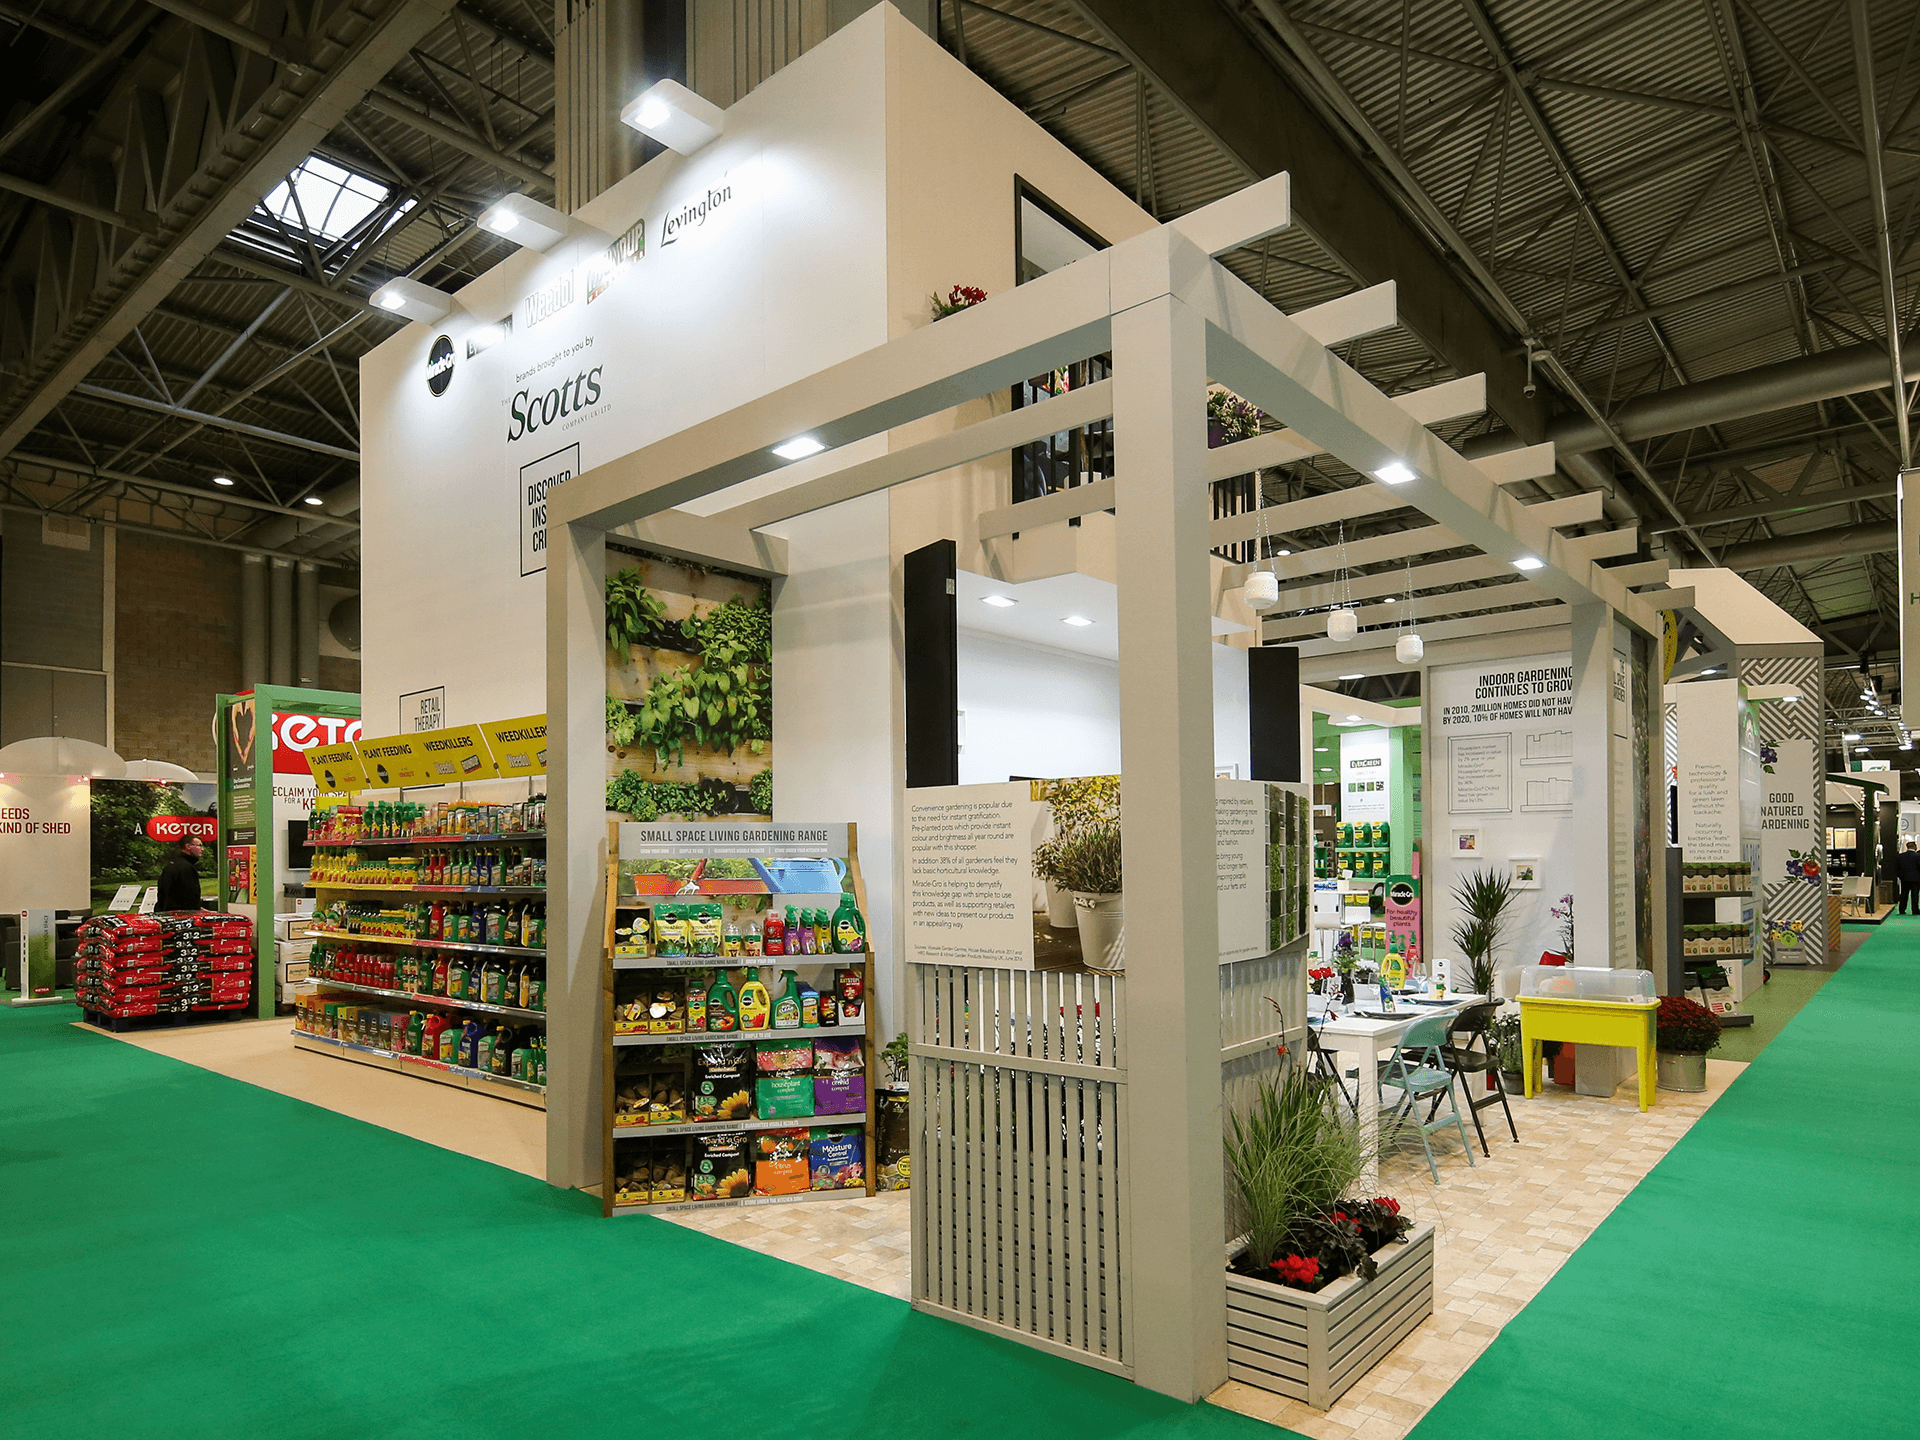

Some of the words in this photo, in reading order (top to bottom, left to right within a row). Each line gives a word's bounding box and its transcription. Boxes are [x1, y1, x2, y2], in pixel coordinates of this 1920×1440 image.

[660, 182, 732, 249] Levington
[516, 366, 535, 382] brands
[537, 353, 562, 372] brought
[563, 348, 570, 358] to
[572, 341, 584, 356] you
[585, 336, 594, 347] by
[507, 364, 603, 442] Scotts
[1479, 673, 1515, 686] INDOOR
[1476, 683, 1528, 699] CONTINUES
[1532, 682, 1544, 694] TO
[420, 696, 440, 714] RETAIL
[1472, 703, 1501, 713] 2MILLION
[1503, 700, 1527, 709] HOMES
[1529, 699, 1540, 708] DID
[1542, 698, 1555, 706] NOT
[415, 713, 441, 732] THERAPY
[1443, 716, 1451, 725] BY
[1474, 713, 1488, 722] 10%
[1490, 712, 1498, 721] OF
[1500, 711, 1523, 720] HOMES
[1525, 709, 1540, 718] WILL
[1543, 708, 1556, 717] NOT
[423, 736, 473, 752] WEEDKILLERS
[363, 748, 381, 759] PLANT
[382, 744, 412, 757] FEEDING
[311, 755, 327, 765] PLANT
[328, 751, 353, 763] FEEDING
[1769, 793, 1794, 803] GOOD
[946, 803, 972, 812] gardening
[979, 801, 1000, 810] popular
[1761, 806, 1803, 816] NATURED
[968, 812, 1001, 821] gratification.
[25, 822, 39, 834] OF
[42, 823, 71, 834] SHED
[134, 823, 143, 835] A
[640, 831, 673, 842] SMALL
[676, 831, 706, 841] SPACE
[709, 831, 740, 841] LIVING
[742, 830, 795, 841] GARDENING
[798, 830, 828, 841] RANGE
[940, 833, 966, 842] brightness
[966, 857, 992, 865] gardeners
[1005, 857, 1018, 865] they
[968, 867, 1000, 876] knowledge.
[948, 880, 968, 889] helping
[976, 880, 1002, 889] demystify
[922, 890, 950, 899] knowledge
[975, 891, 993, 900] simple
[962, 901, 992, 910] supporting
[926, 920, 951, 929] appealing
[822, 1143, 852, 1152] Moisture
